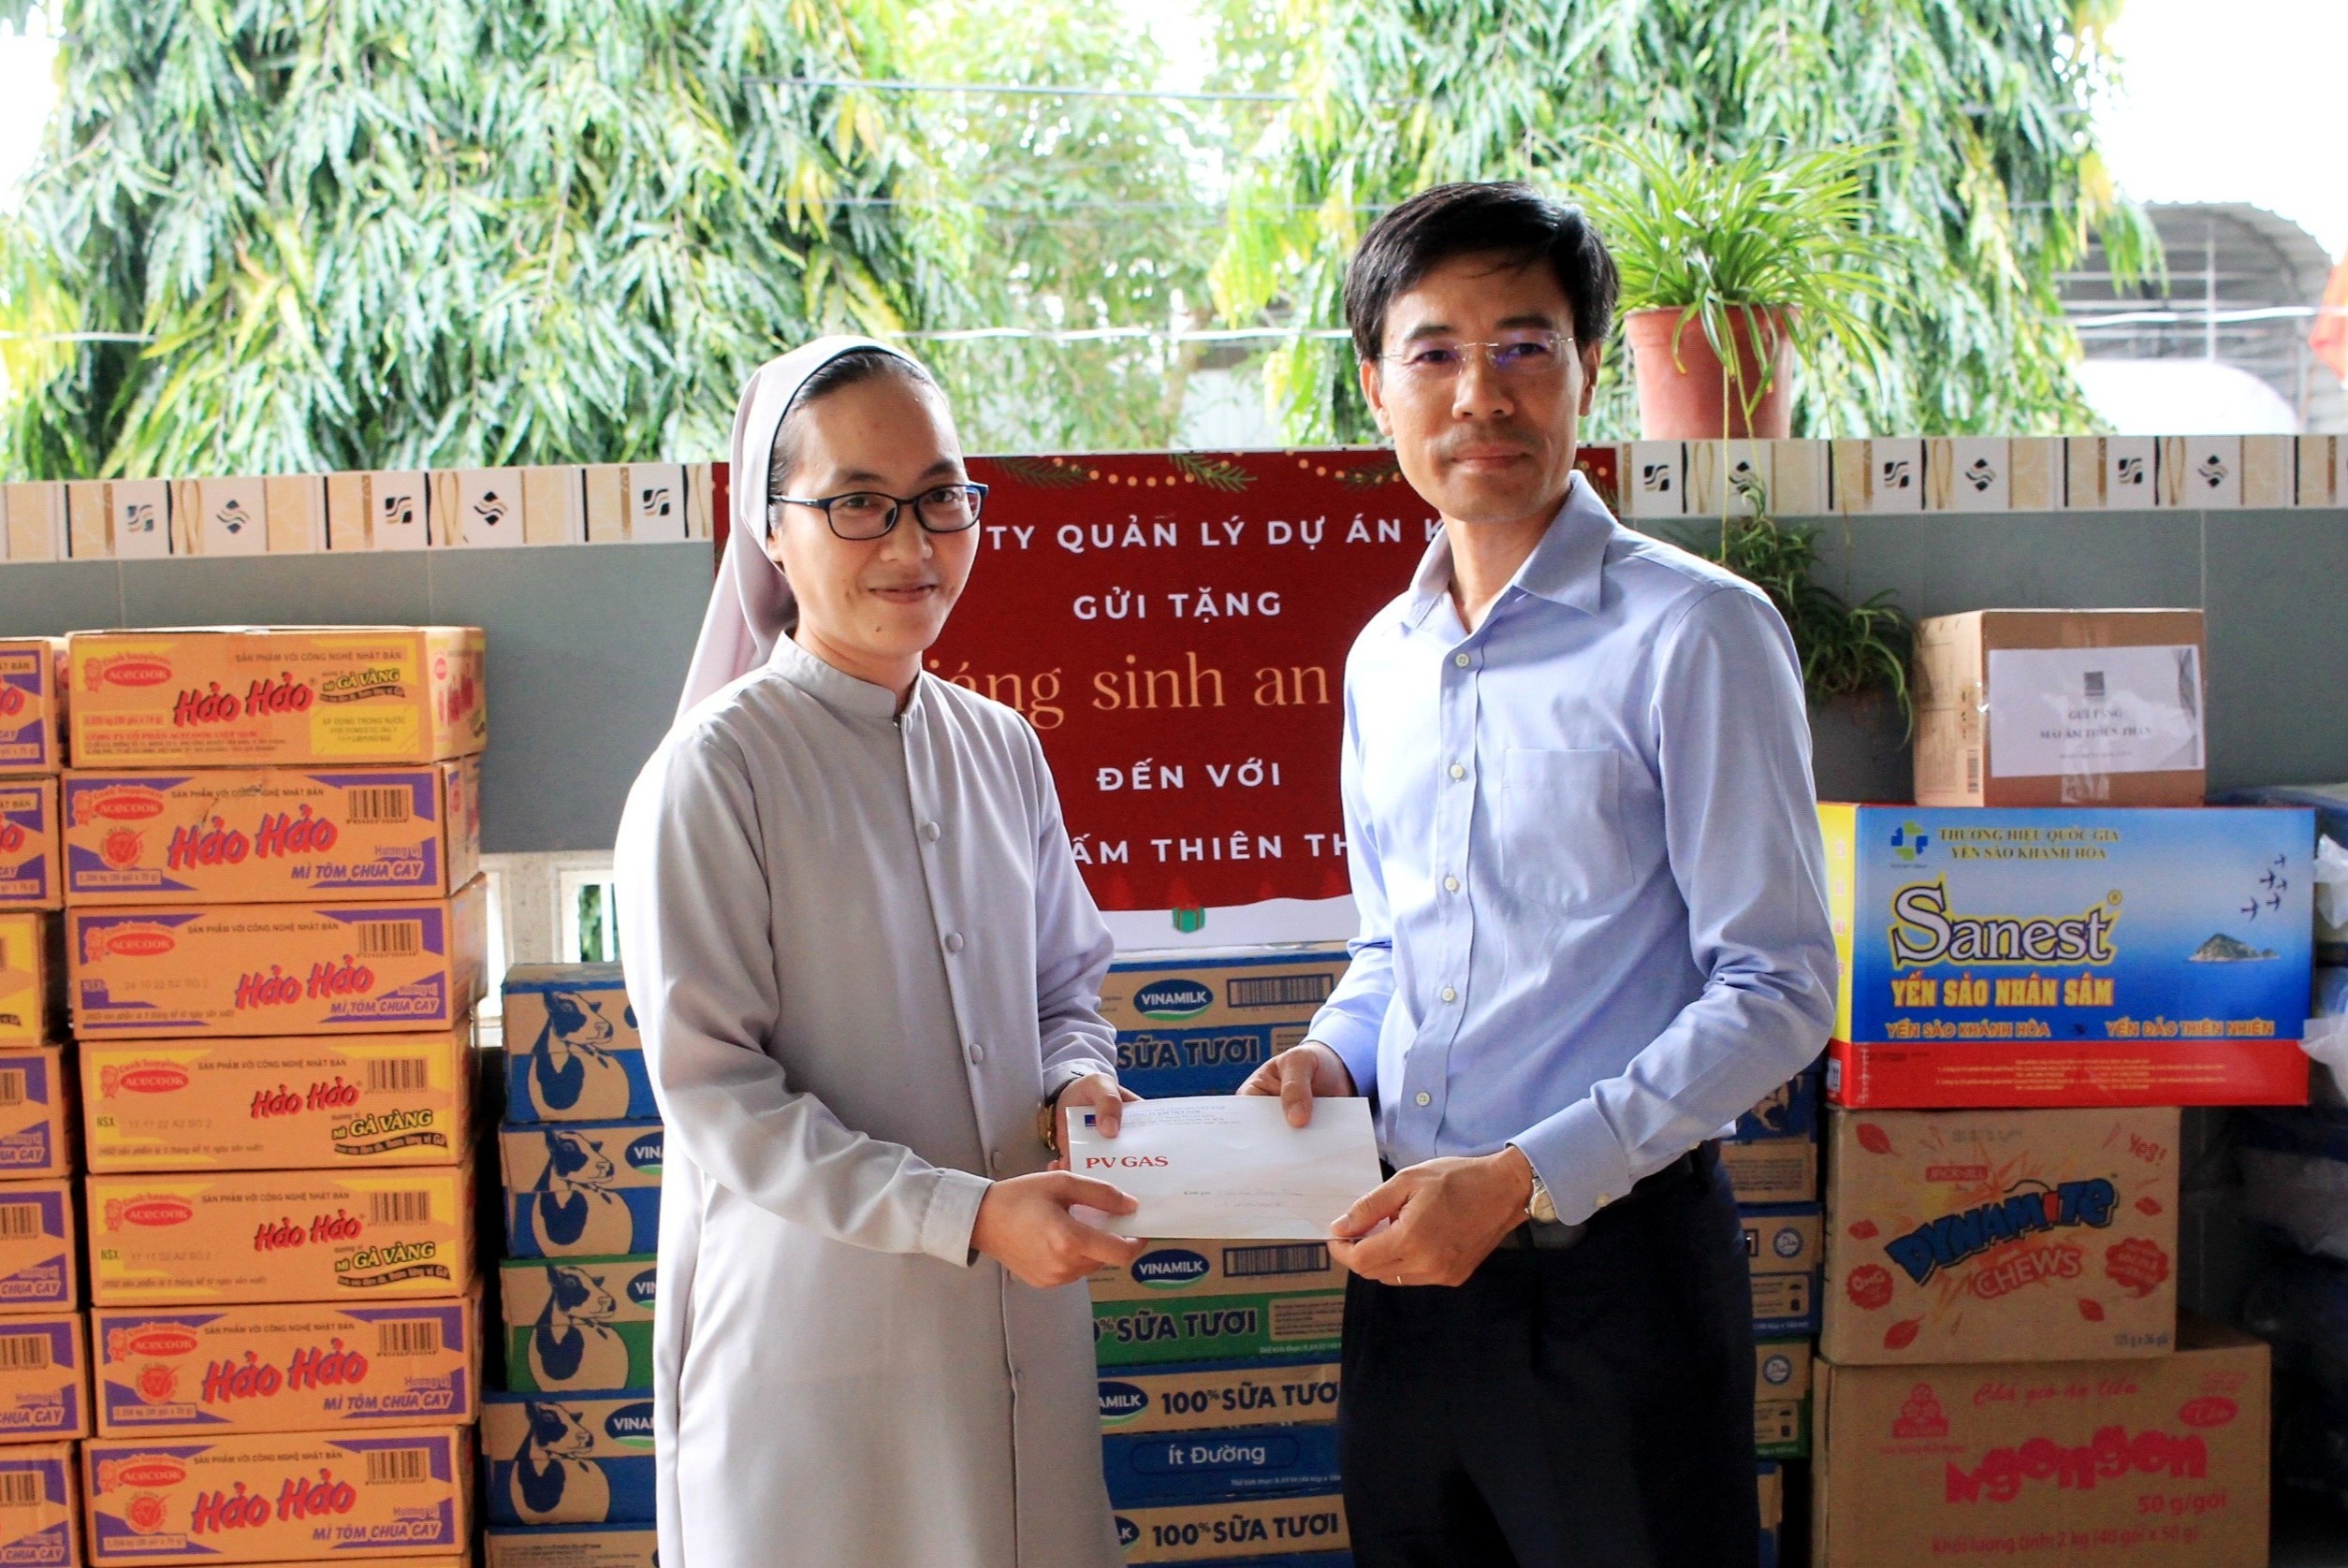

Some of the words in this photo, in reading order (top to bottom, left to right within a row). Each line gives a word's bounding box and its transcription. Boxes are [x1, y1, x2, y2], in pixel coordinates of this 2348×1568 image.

[986, 526, 1034, 550] TY
[1057, 515, 1177, 553] QUẢN
[1202, 515, 1246, 546] LÝ
[1267, 516, 1325, 550] DỰ
[1346, 514, 1401, 543] ÁN
[1073, 588, 1145, 619] GỬI
[1168, 588, 1281, 624] TẶNG
[1092, 651, 1225, 710] sinh
[1254, 664, 1330, 706] an
[173, 682, 241, 727] Hảo
[245, 672, 314, 718] Hảo
[1096, 758, 1184, 791] ĐẾN
[1206, 757, 1280, 788] VỚI
[168, 815, 250, 871] Hảo
[255, 803, 338, 859] Hảo
[1151, 831, 1282, 863] THIÊN
[2093, 828, 2119, 841] GIA
[351, 864, 389, 878] CHUA
[393, 863, 422, 878] CAY
[1891, 880, 2115, 964] Sanest
[235, 965, 302, 1009] Hảo
[307, 953, 374, 999] Hảo
[1891, 970, 1937, 1007] YẾN
[1994, 971, 2058, 1007] NHÂN
[2064, 971, 2114, 1007] SÂM
[379, 1000, 411, 1012] CHUA
[414, 999, 438, 1011] CAY
[1141, 991, 1206, 1006] VINAMILK
[1116, 1036, 1179, 1068] SỮA
[1184, 1036, 1260, 1065] TƯƠI
[251, 1084, 303, 1119] Hảo
[307, 1076, 359, 1111] Hảo
[350, 1113, 378, 1137] GÀ
[379, 1109, 433, 1132] VÀNG
[1086, 1157, 1116, 1169] PV
[1121, 1156, 1169, 1167] GAS
[255, 1216, 306, 1252] Hảo
[310, 1209, 362, 1243] Hảo
[354, 1246, 381, 1270] GÀ
[382, 1241, 436, 1264] VÀNG
[1139, 1260, 1203, 1275] VINAMILK
[36, 1282, 59, 1293] CAY
[1975, 1247, 2082, 1299] CHEWS
[1116, 1310, 1178, 1342] SỮA
[1184, 1309, 1257, 1337] TƯƠI
[201, 1350, 283, 1405] Hảo
[287, 1337, 369, 1391] Hảo
[382, 1395, 419, 1408] CHUA
[423, 1392, 452, 1406] CAY
[1222, 1382, 1276, 1411] SỮA
[35, 1411, 63, 1422] CAY
[1169, 1445, 1184, 1465] Ít
[1190, 1445, 1265, 1465] Đường
[191, 1481, 271, 1535] Hảo
[277, 1468, 357, 1522] Hảo
[371, 1523, 407, 1538] CHUA
[412, 1522, 440, 1536] CAY
[1213, 1515, 1268, 1544] SỮA
[1274, 1513, 1338, 1539] TƯƠI
